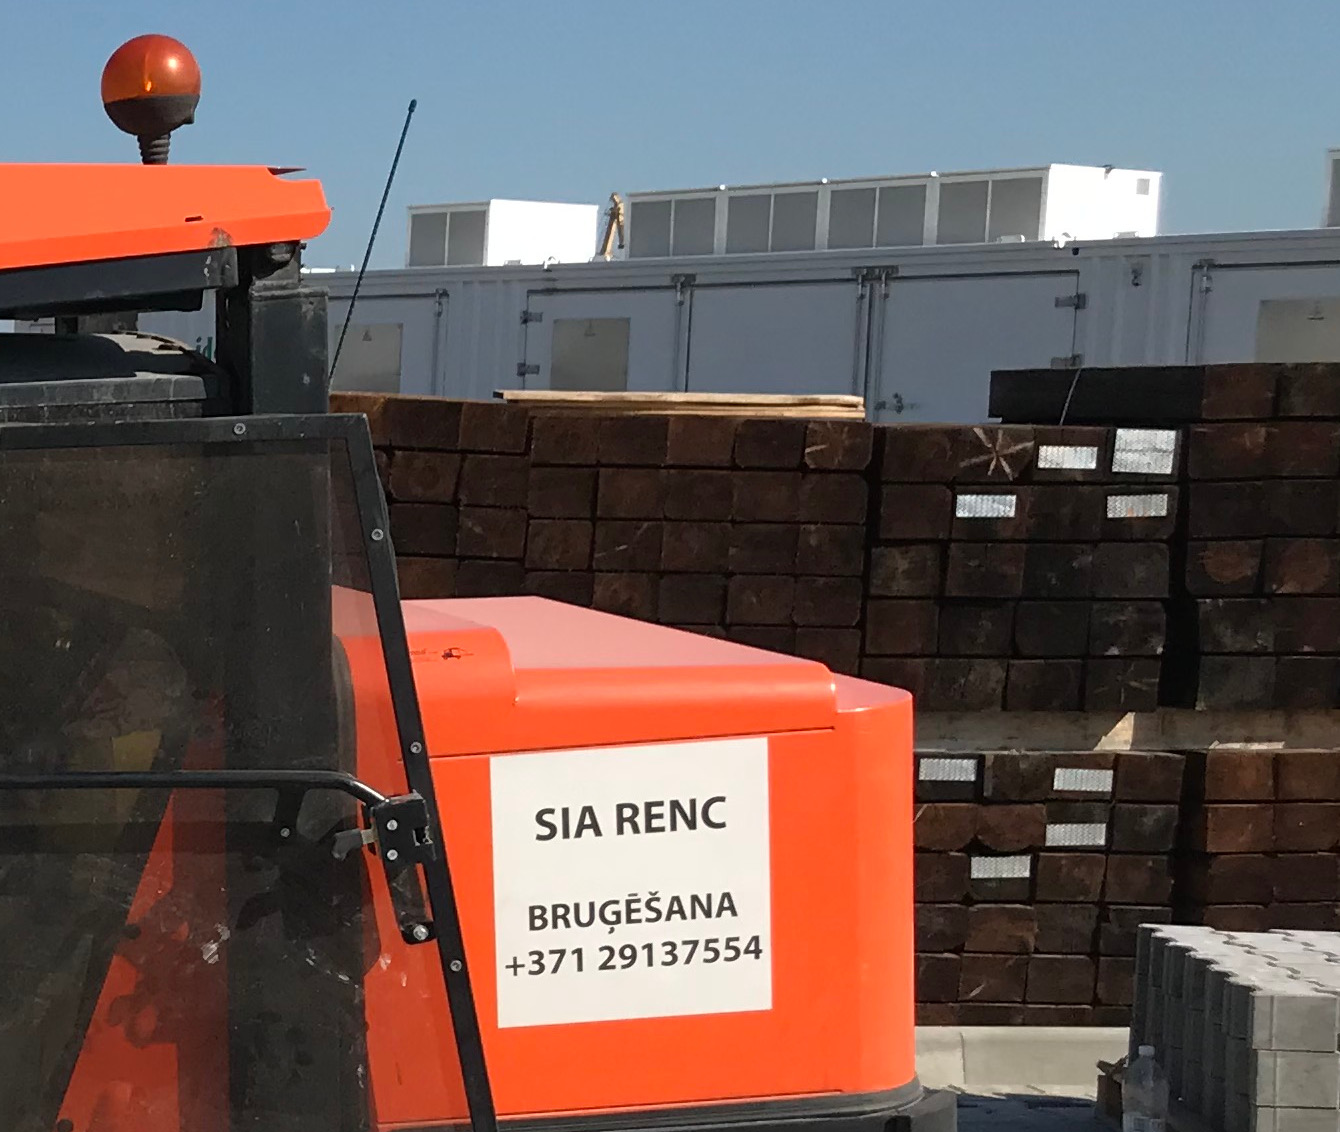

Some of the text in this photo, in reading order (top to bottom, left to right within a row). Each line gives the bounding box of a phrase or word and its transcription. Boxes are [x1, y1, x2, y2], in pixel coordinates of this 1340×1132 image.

[535, 796, 727, 841] SIA RENC
[528, 891, 738, 934] BRUĢĒŠANA
[505, 935, 763, 977] +371 29137554
